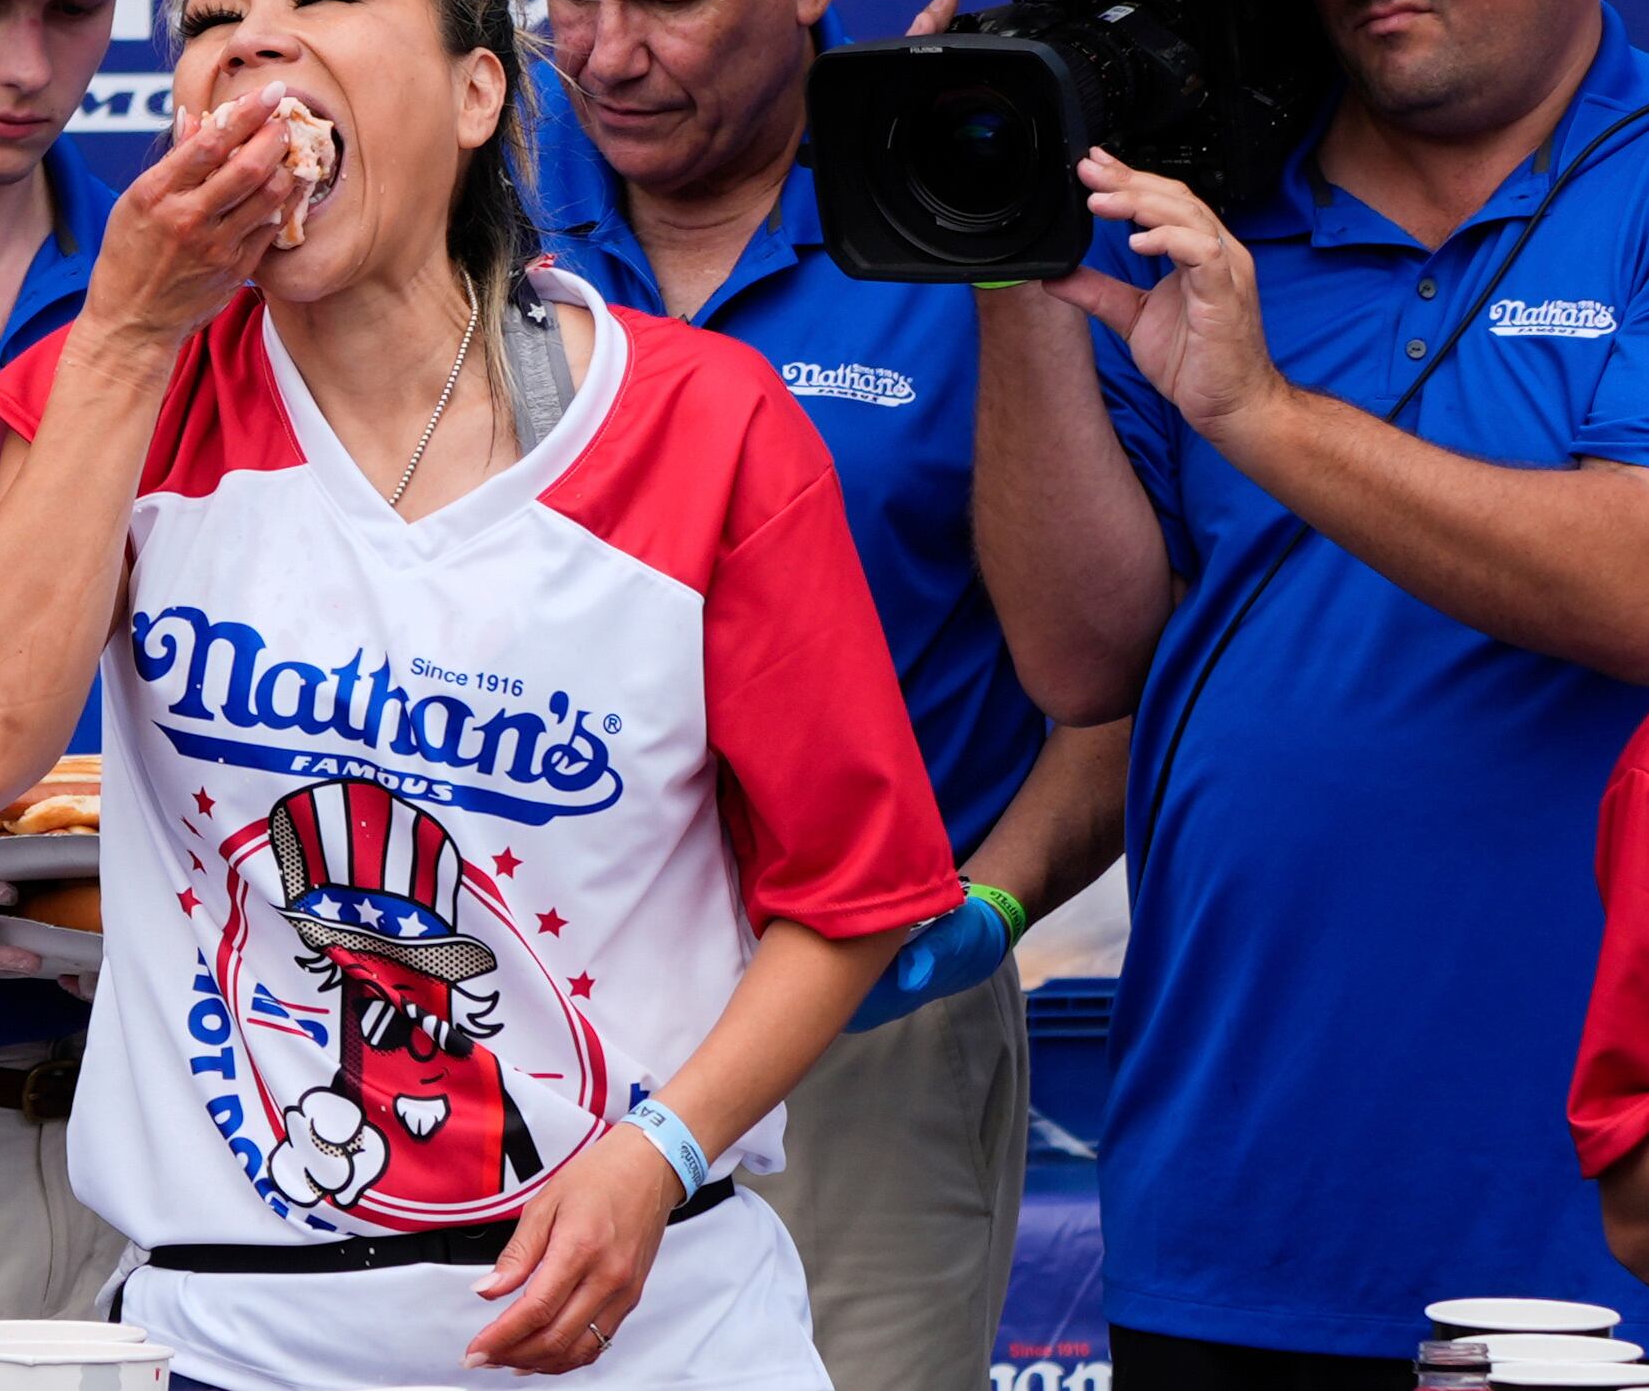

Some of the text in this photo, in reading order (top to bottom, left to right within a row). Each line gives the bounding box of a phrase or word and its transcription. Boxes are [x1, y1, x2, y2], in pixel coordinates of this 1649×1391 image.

[1489, 300, 1612, 328] Nathan's
[782, 362, 910, 397] Nathan's
[410, 657, 524, 697] Since 1916
[132, 606, 609, 792] Nathan's
[290, 755, 453, 802] FAMOUS
